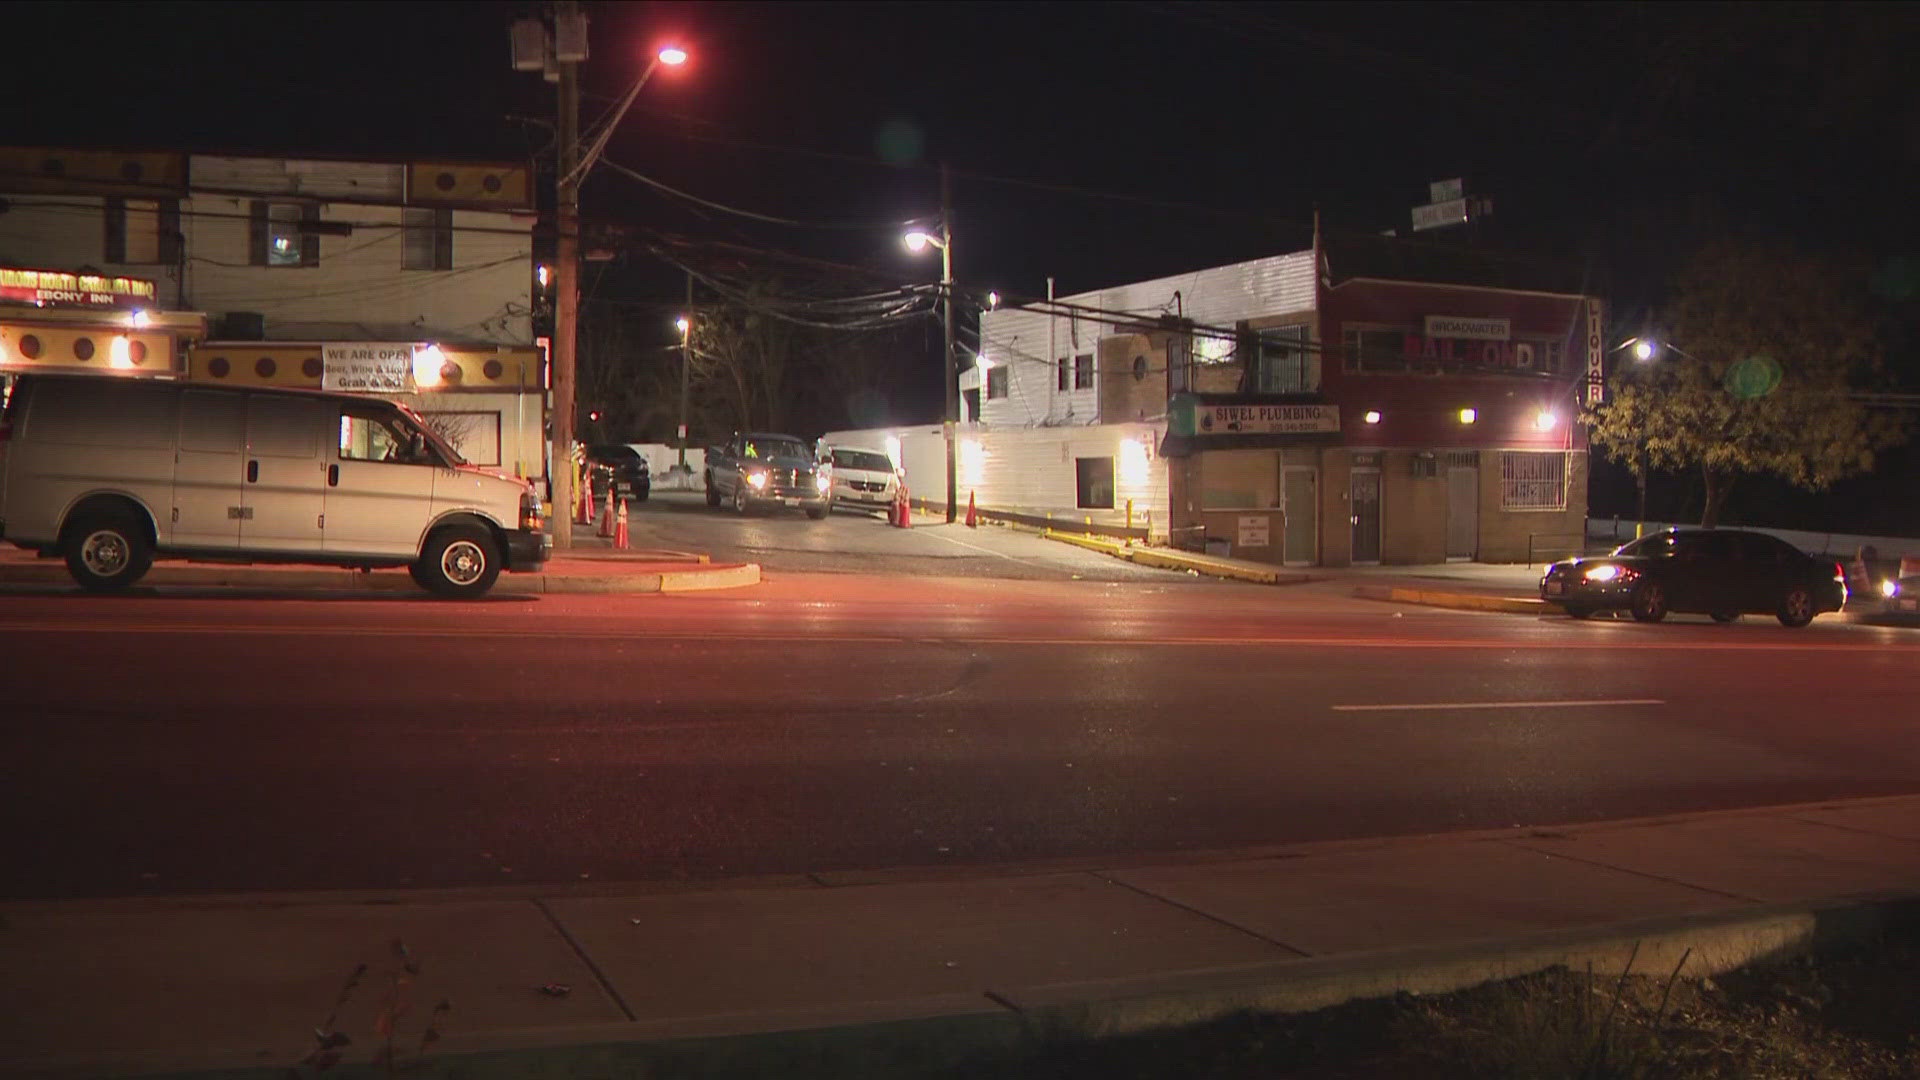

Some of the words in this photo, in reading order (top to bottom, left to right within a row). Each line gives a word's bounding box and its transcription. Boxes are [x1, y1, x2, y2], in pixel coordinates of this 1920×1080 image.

[39, 272, 77, 291] NORTH
[132, 280, 154, 299] BBQ
[36, 290, 84, 302] EBONY
[90, 293, 114, 304] INN
[1431, 321, 1505, 335] BROADWATER
[327, 349, 346, 359] WE
[351, 350, 375, 360] ARE
[1589, 300, 1600, 401] LIQUOR
[376, 365, 383, 374] &
[338, 378, 366, 388] Grab
[370, 379, 380, 388] &
[1216, 408, 1255, 420] SIWEL
[1259, 408, 1320, 420] PLUMBING
